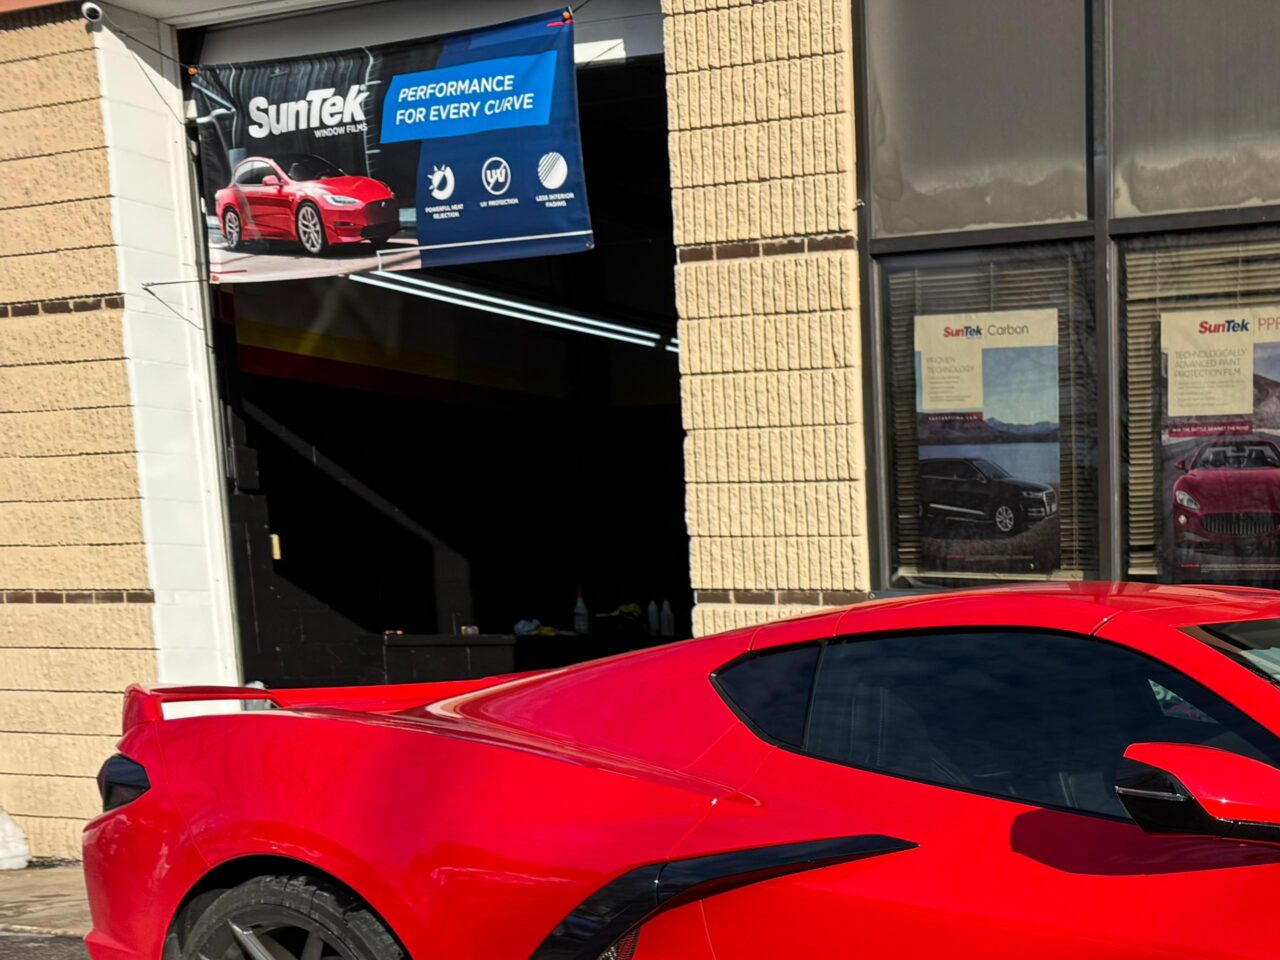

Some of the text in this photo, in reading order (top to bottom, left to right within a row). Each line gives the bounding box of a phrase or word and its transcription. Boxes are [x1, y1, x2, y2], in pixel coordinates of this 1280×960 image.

[398, 75, 515, 102] PERFORMANCE
[248, 84, 370, 138] SunTek
[396, 93, 534, 125] FOR EVERY CURVE
[314, 123, 369, 138] WINDOW FILMS
[943, 324, 1029, 338] SunTek Carbon
[1198, 318, 1249, 334] SunTek
[1175, 349, 1247, 359] TECHNOLOGICALLY
[927, 365, 974, 374] TECHNOLOGY
[1175, 358, 1241, 369] ADVANCED PAINT
[1174, 368, 1241, 377] PROTECTION FILM
